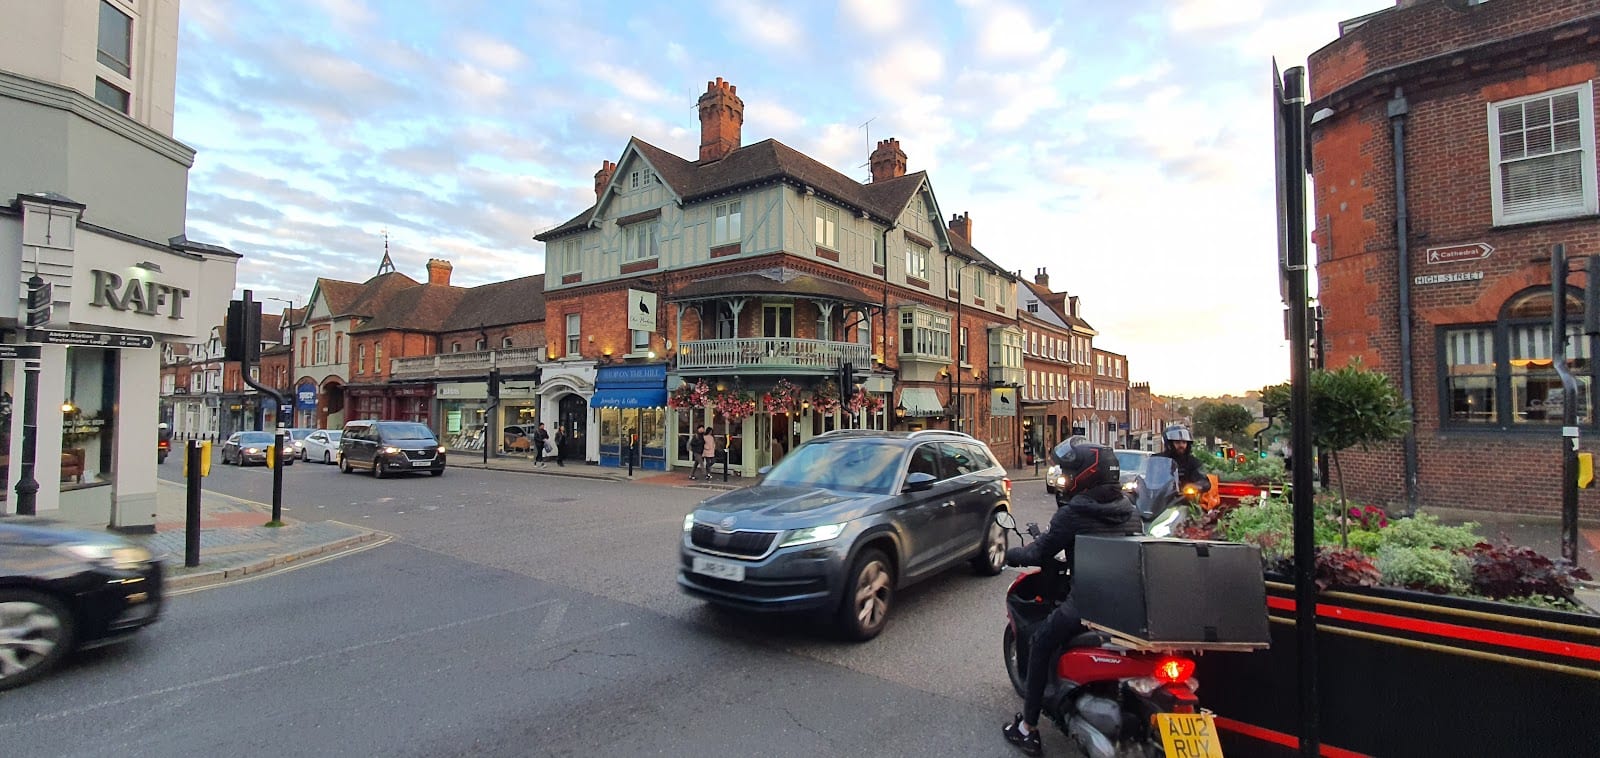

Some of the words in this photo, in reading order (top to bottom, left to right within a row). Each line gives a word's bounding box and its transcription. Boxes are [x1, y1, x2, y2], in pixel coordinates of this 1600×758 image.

[1440, 249, 1479, 258] Cathedral
[1416, 275, 1439, 284] HIGH
[1444, 272, 1481, 282] STREET
[88, 269, 190, 320] RAFT
[644, 367, 660, 377] HILL
[1089, 655, 1121, 664] VISION
[1169, 717, 1210, 737] AU12
[1173, 738, 1210, 758] RUY
